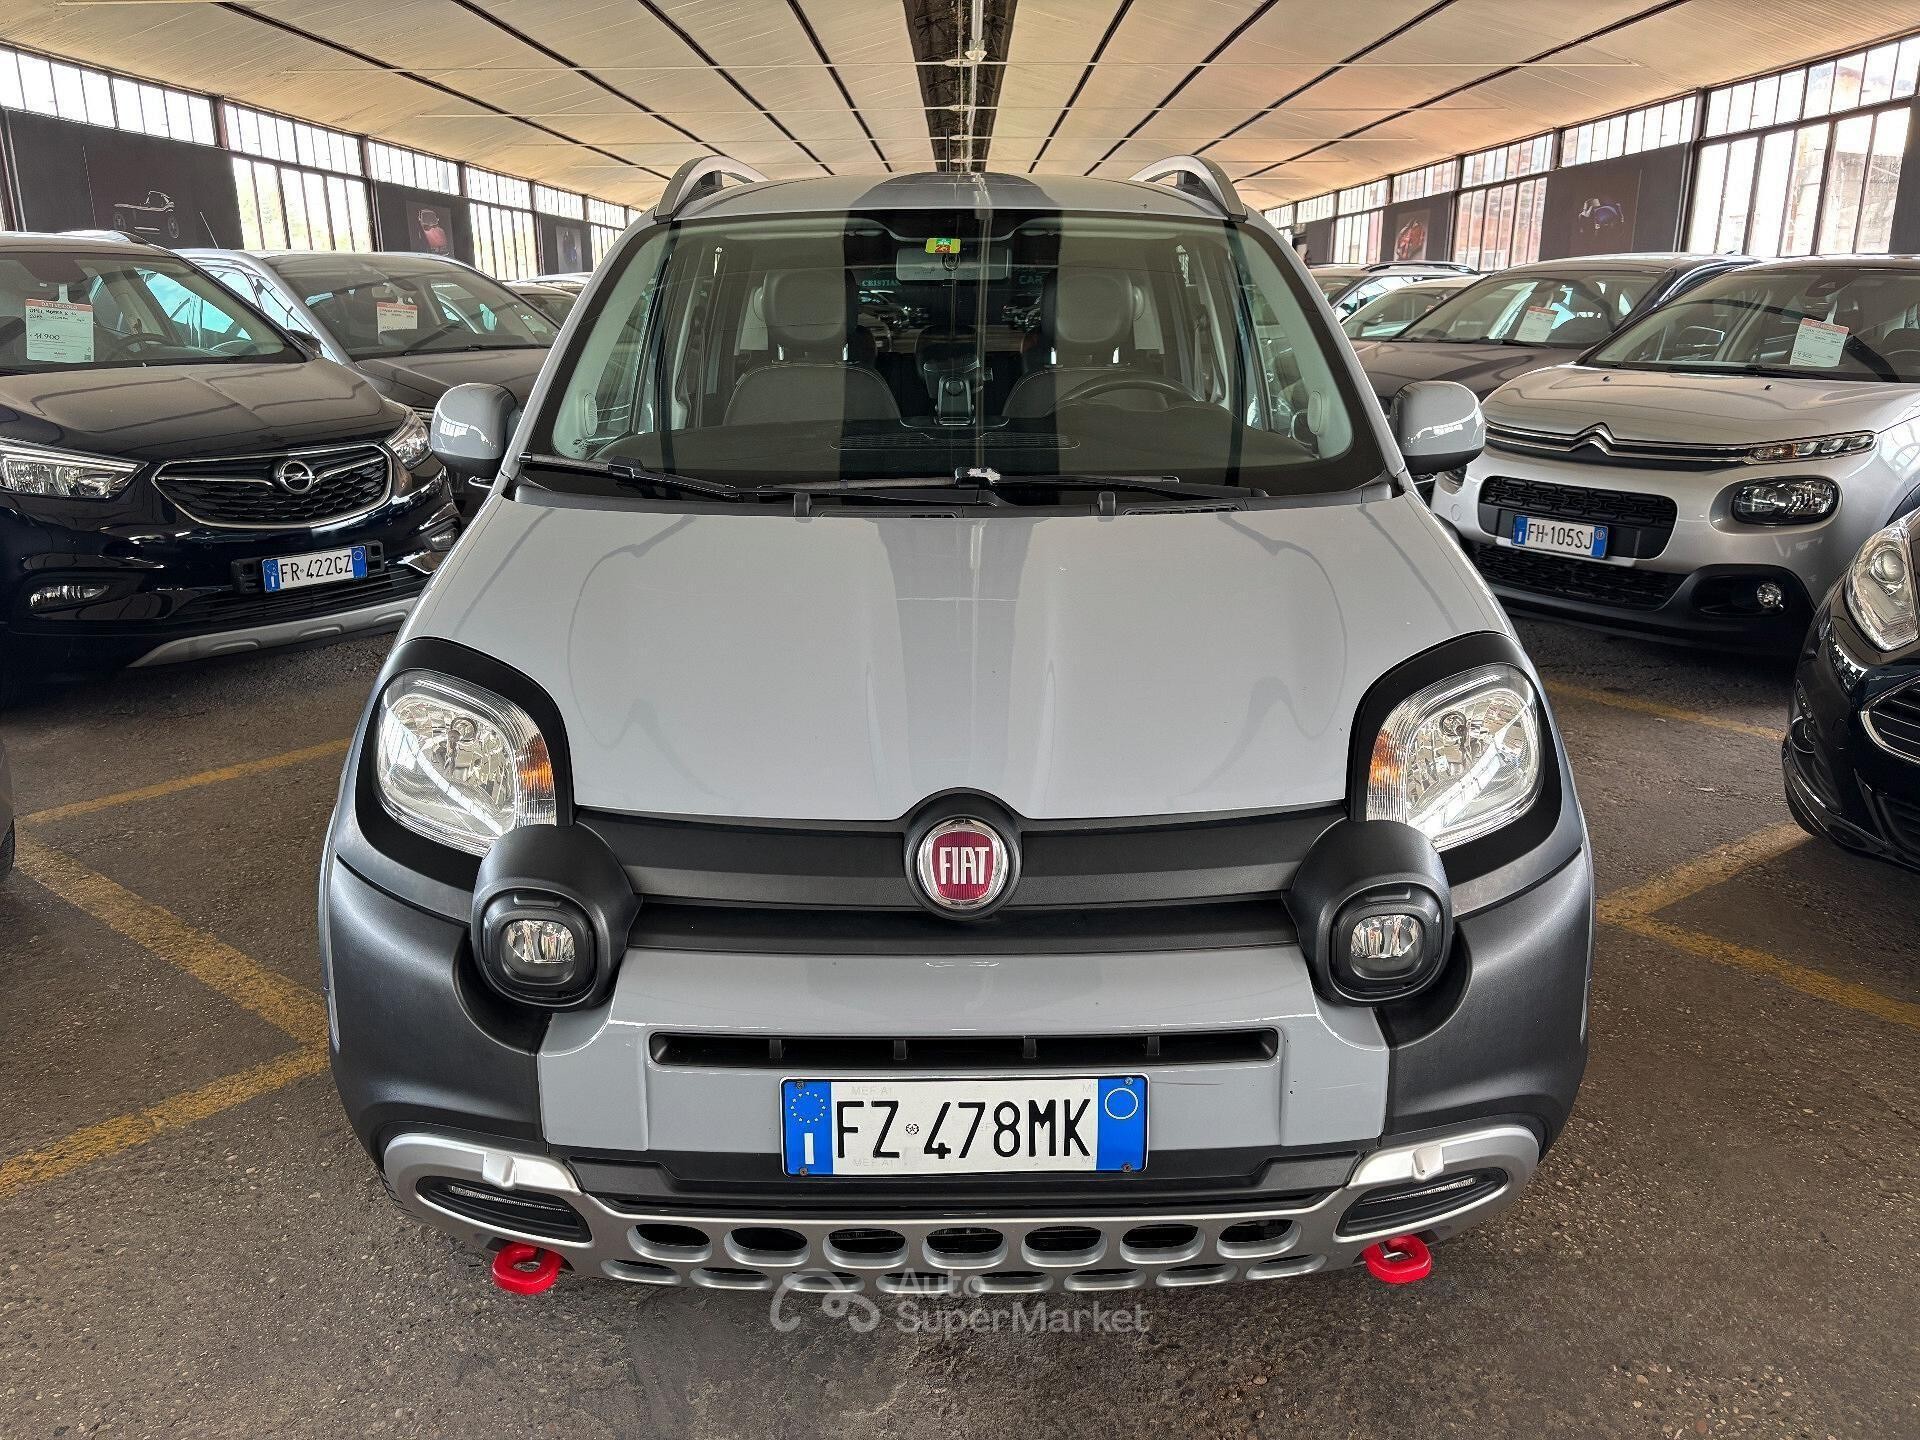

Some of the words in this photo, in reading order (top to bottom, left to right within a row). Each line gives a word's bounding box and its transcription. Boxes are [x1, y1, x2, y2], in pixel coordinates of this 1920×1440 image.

[1527, 524, 1545, 543] FH
[1551, 526, 1593, 550] 105SJ
[280, 562, 300, 582] FR
[306, 555, 353, 579] 422GZ
[939, 846, 990, 885] FIAT
[836, 1100, 900, 1159] FZ
[923, 1098, 1091, 1159] 478MK
